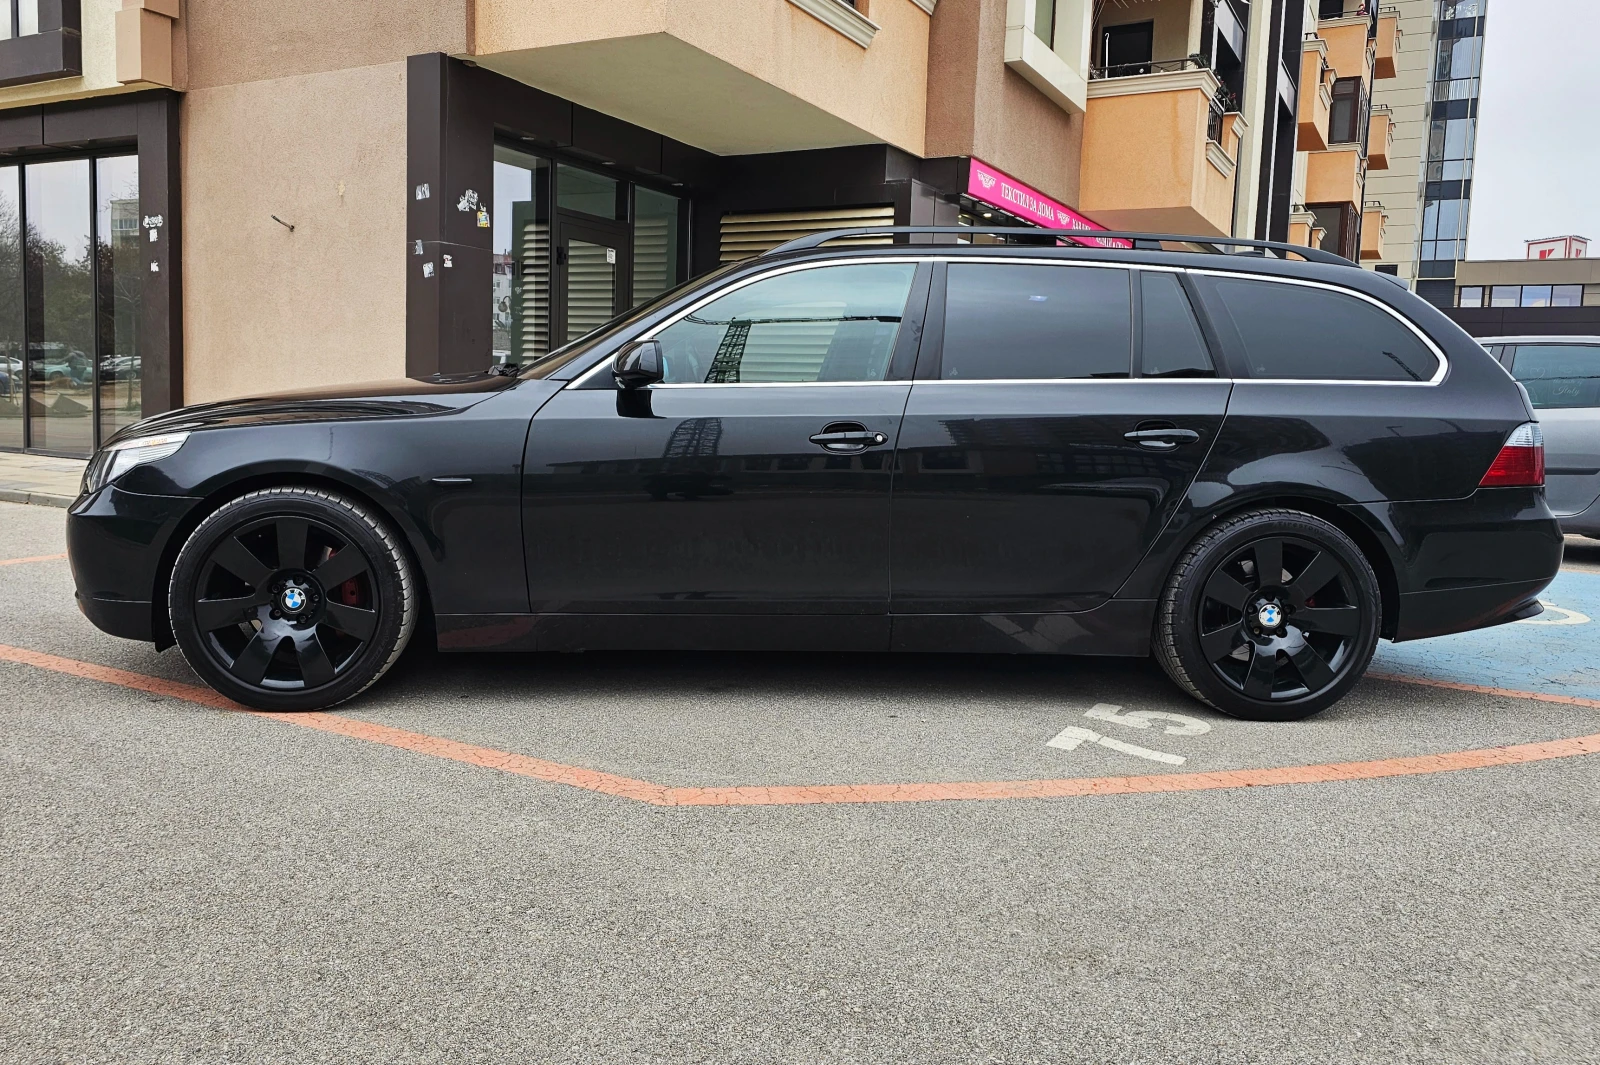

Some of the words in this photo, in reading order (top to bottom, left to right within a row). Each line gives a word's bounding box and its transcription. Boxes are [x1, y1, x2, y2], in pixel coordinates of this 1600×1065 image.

[1001, 182, 1029, 209] ТЕКСТИЛ
[1029, 196, 1037, 213] ЗА
[1037, 201, 1055, 221] ДОМА
[1552, 385, 1580, 397] Italy
